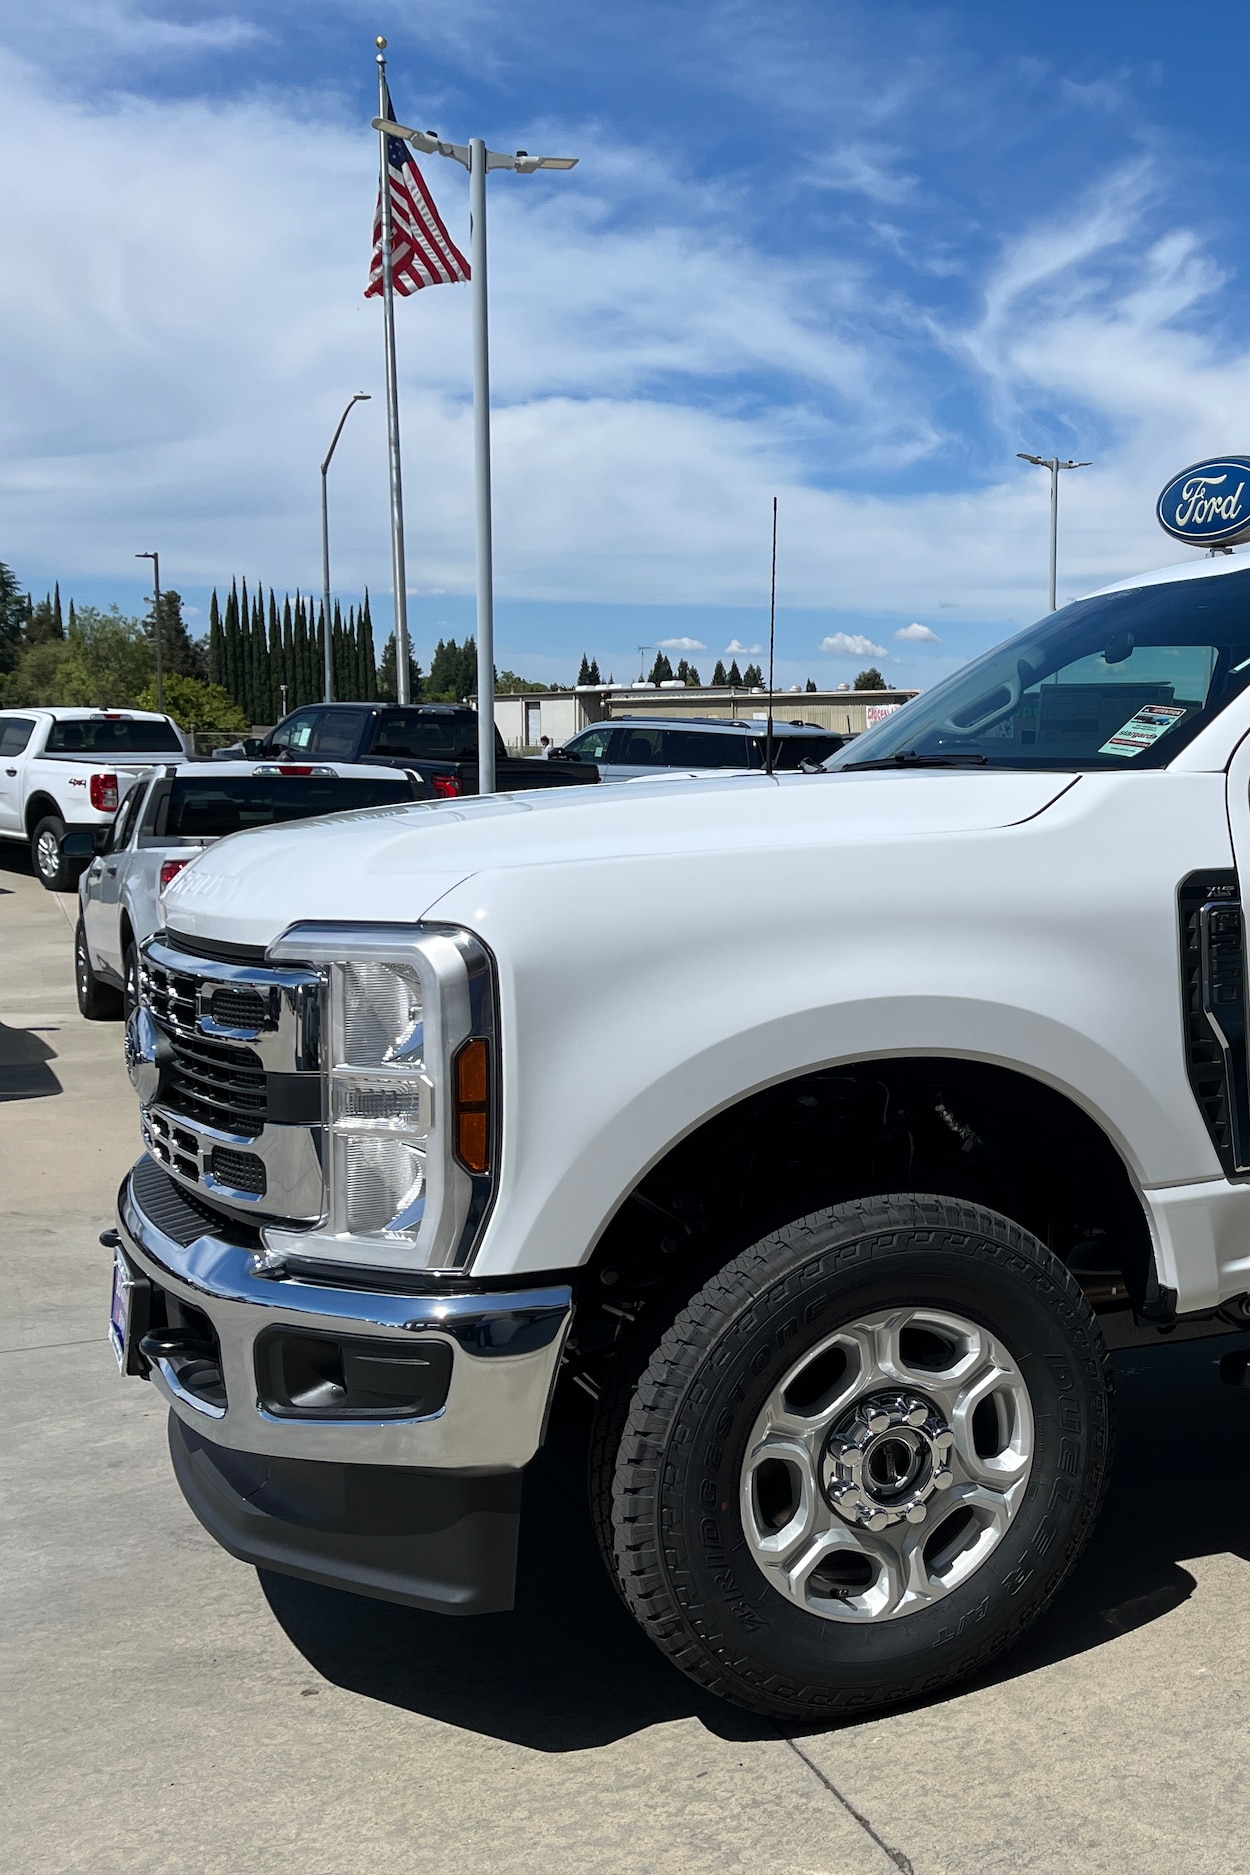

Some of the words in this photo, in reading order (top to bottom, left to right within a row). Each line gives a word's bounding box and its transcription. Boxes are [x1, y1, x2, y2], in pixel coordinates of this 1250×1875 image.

[1175, 474, 1245, 527] Ford
[1206, 885, 1235, 898] XLT
[699, 1292, 829, 1633] BRIDGESTONE
[1001, 1352, 1081, 1598] DUELER
